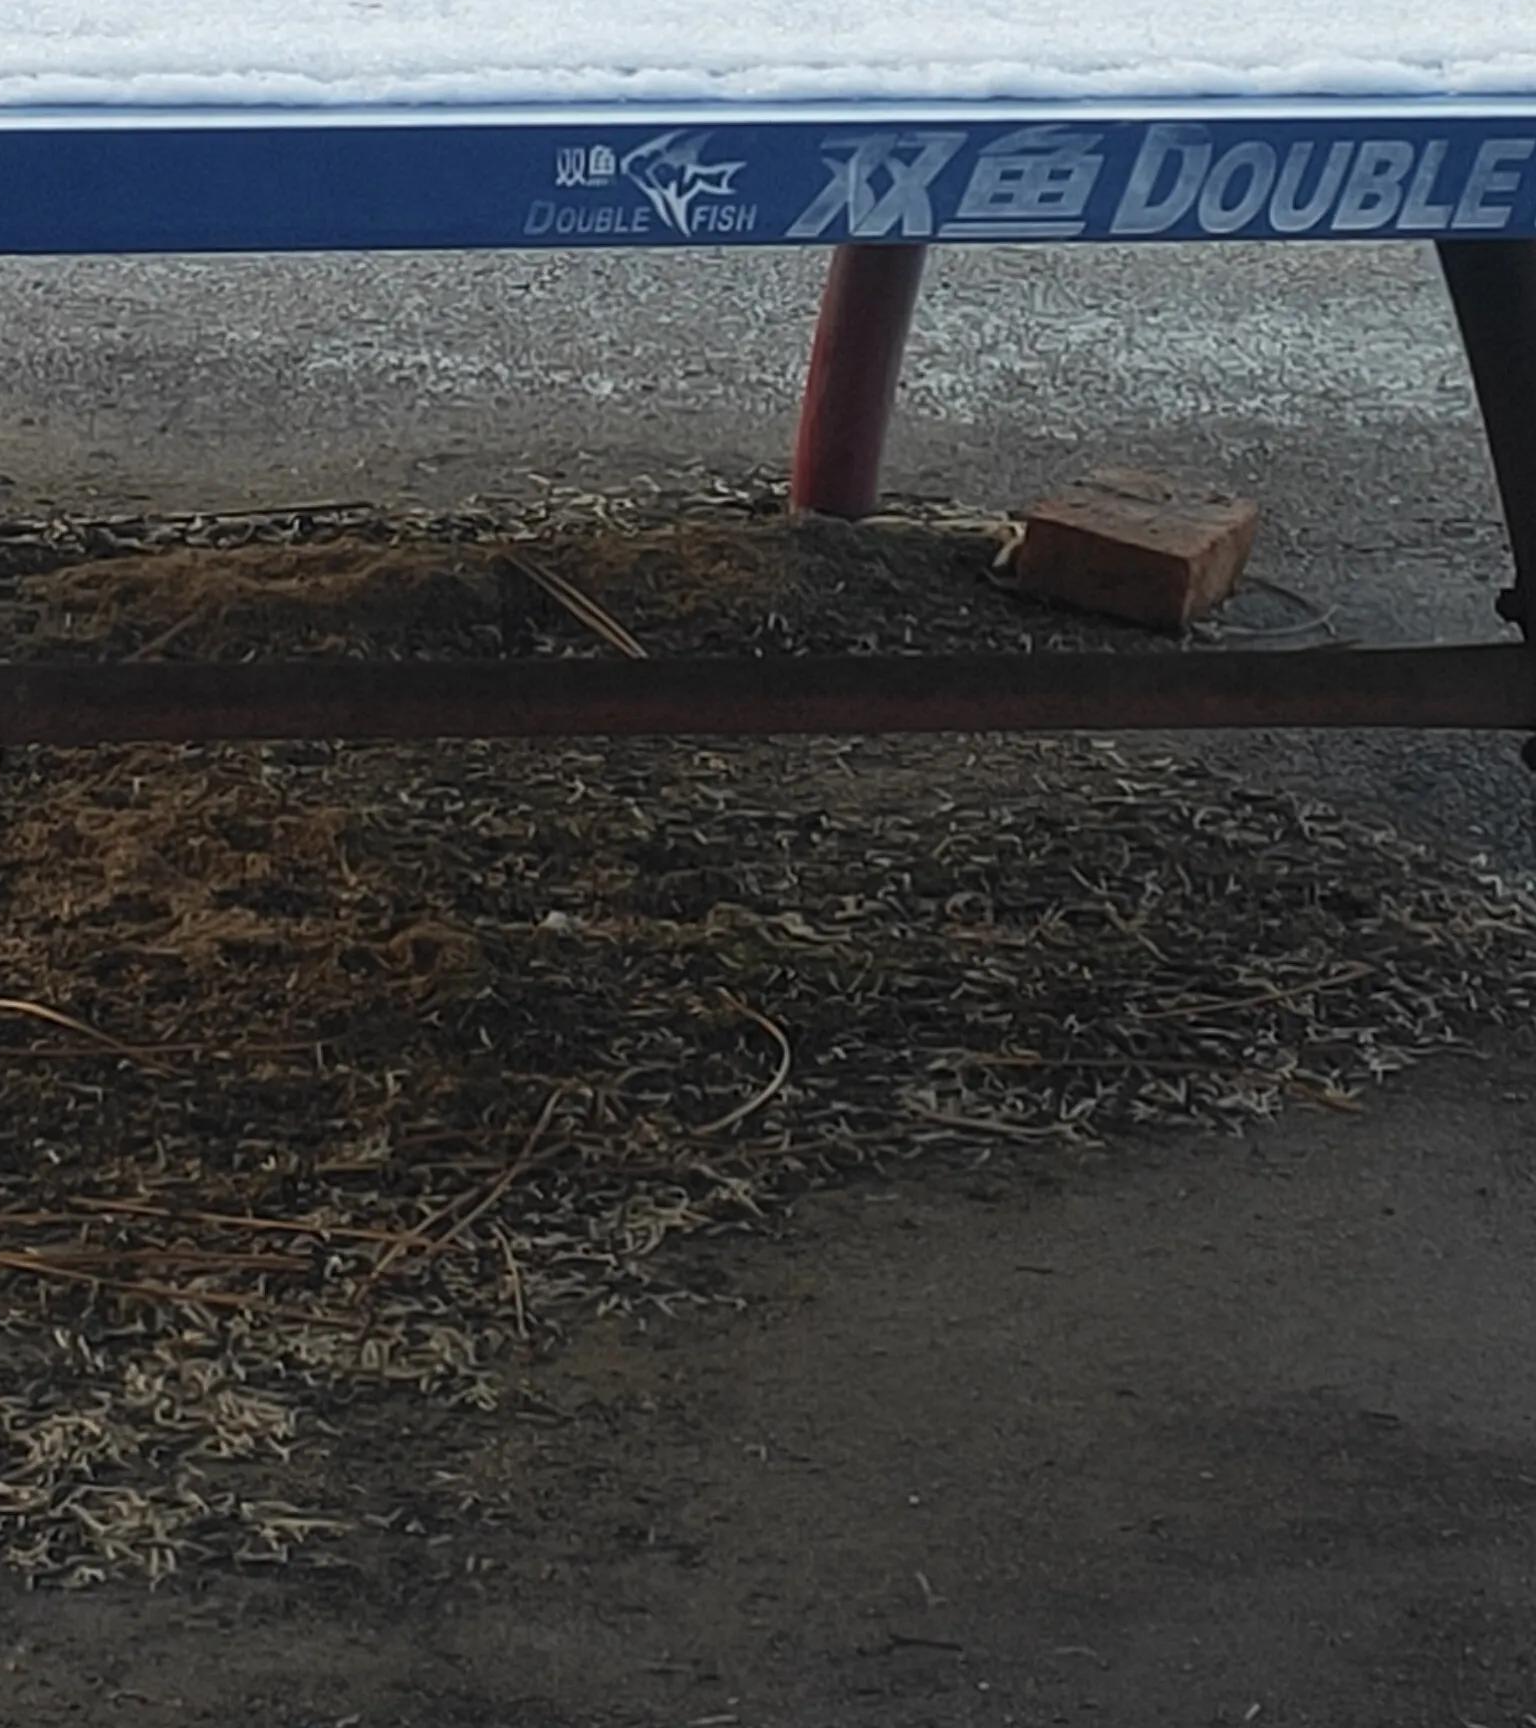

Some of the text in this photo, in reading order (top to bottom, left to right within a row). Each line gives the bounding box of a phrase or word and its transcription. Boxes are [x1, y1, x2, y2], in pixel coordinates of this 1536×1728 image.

[556, 145, 616, 186] 双鱼
[786, 126, 1103, 237] 双鱼
[1110, 124, 1534, 234] DOUBLE
[525, 200, 756, 233] DOUBLE FISH
